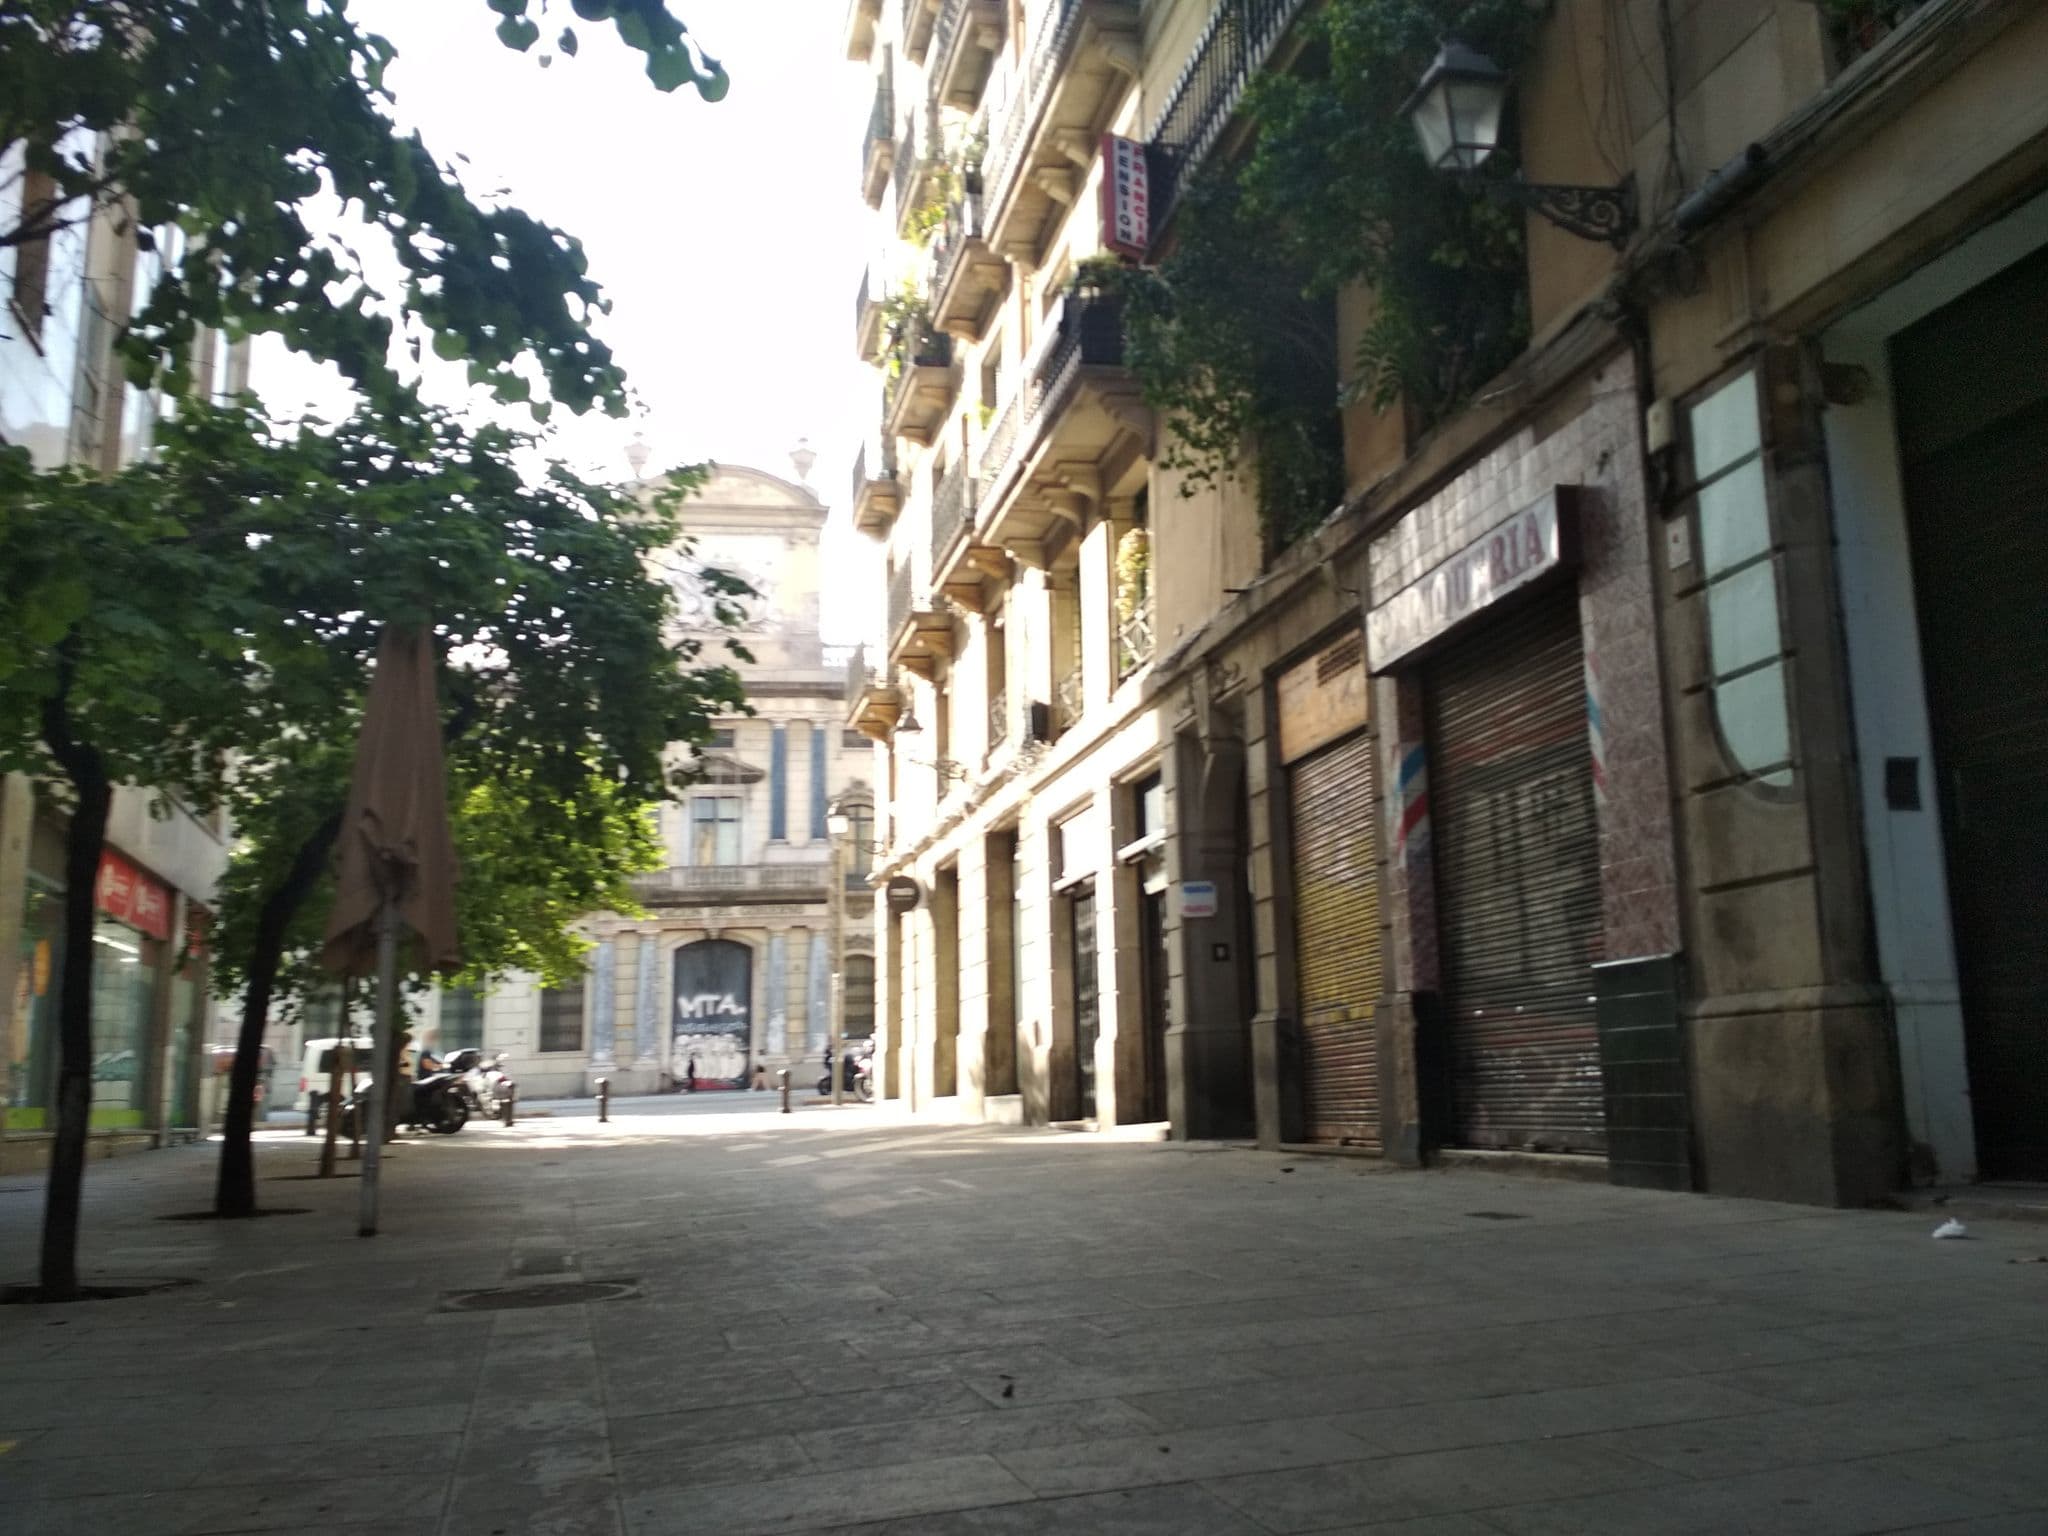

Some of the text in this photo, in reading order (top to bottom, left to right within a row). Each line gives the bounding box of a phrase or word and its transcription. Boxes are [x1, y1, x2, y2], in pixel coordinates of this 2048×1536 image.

[1117, 140, 1132, 241] PENSION
[1133, 146, 1146, 246] FRANCIA
[1370, 511, 1546, 662] PQUERIA
